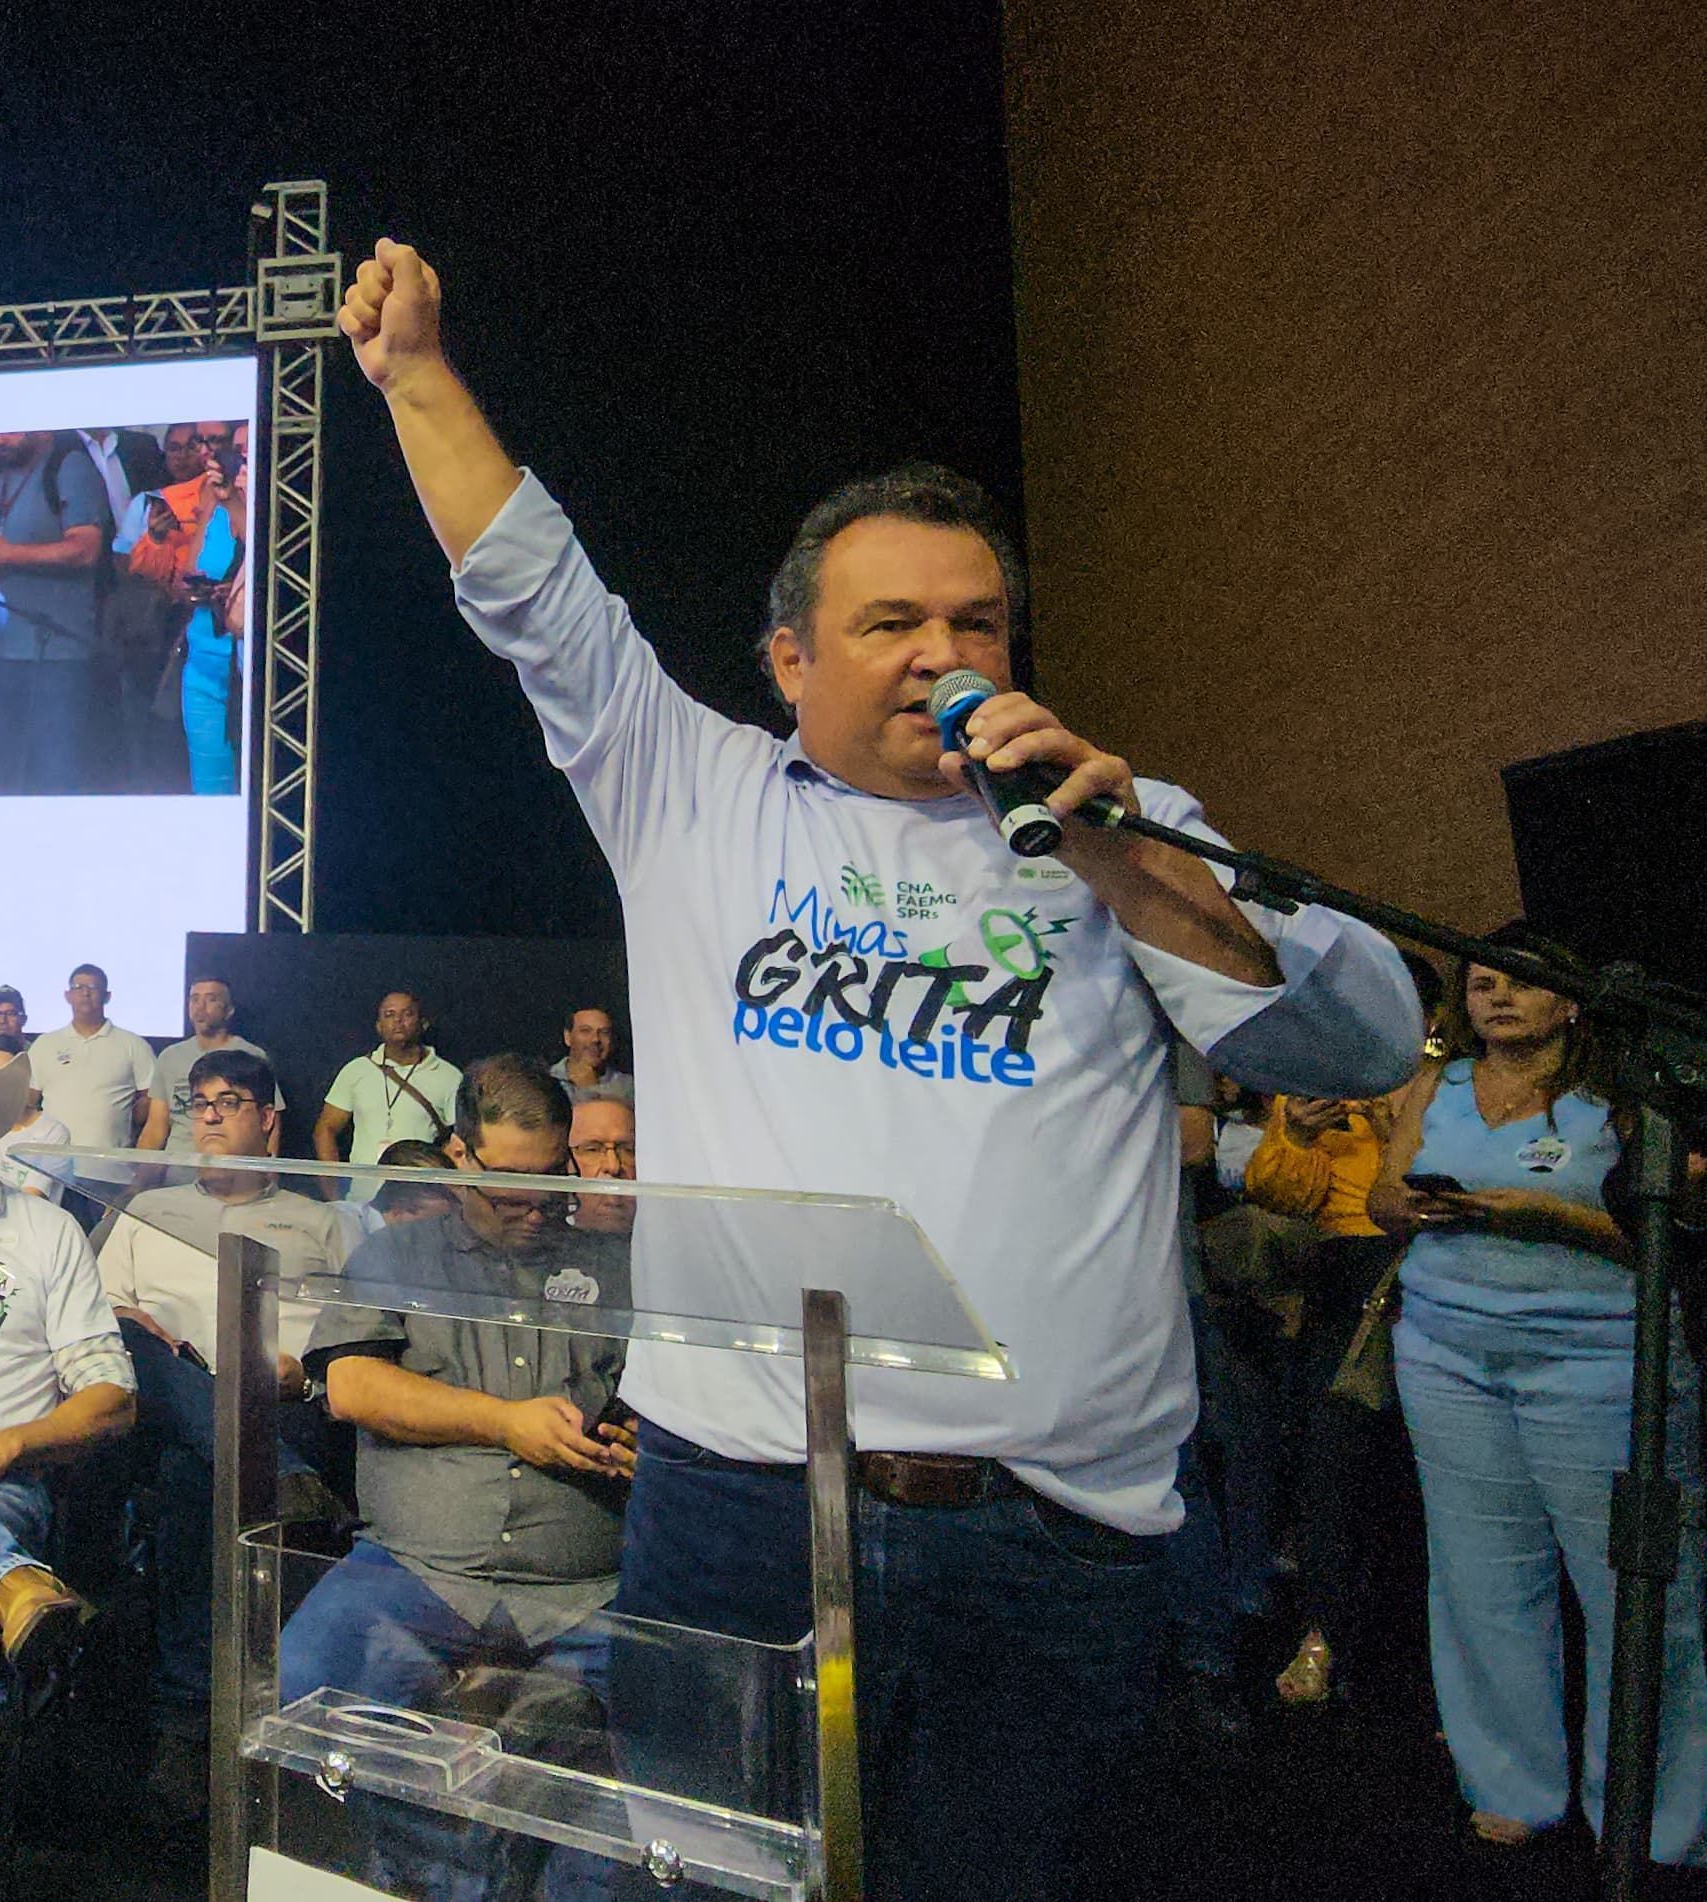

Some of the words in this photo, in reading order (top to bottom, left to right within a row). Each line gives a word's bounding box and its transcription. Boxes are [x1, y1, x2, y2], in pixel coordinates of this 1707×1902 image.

[767, 878, 909, 959] Minas
[896, 880, 934, 894] CNA
[896, 893, 957, 906] FAEMG
[734, 928, 1054, 1055] GRITA
[733, 1000, 864, 1062] pelo
[879, 1017, 1036, 1088] leite
